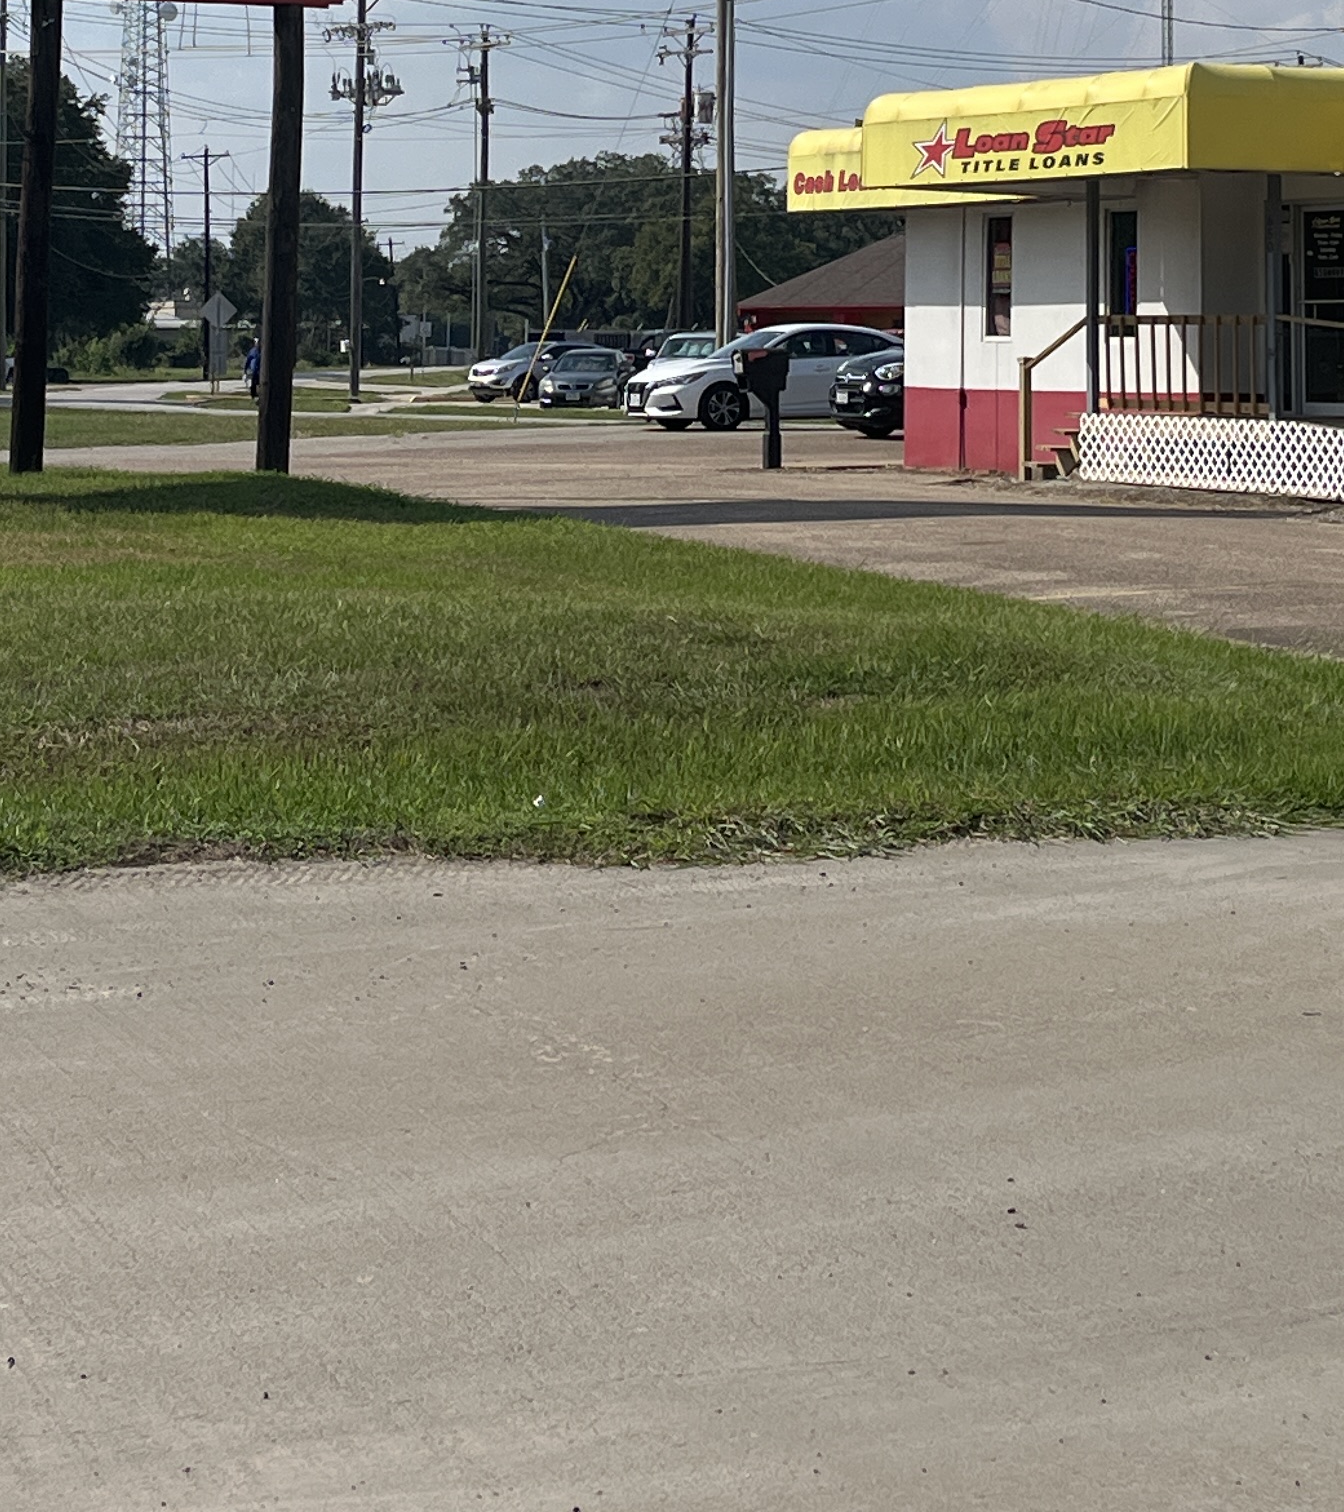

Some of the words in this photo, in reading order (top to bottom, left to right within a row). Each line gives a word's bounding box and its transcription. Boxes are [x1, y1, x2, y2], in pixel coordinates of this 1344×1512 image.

[952, 128, 1030, 159] Loan
[1032, 120, 1115, 154] Star
[961, 157, 1019, 174] TITLE
[1029, 151, 1105, 170] LOANS
[793, 170, 834, 195] Cash
